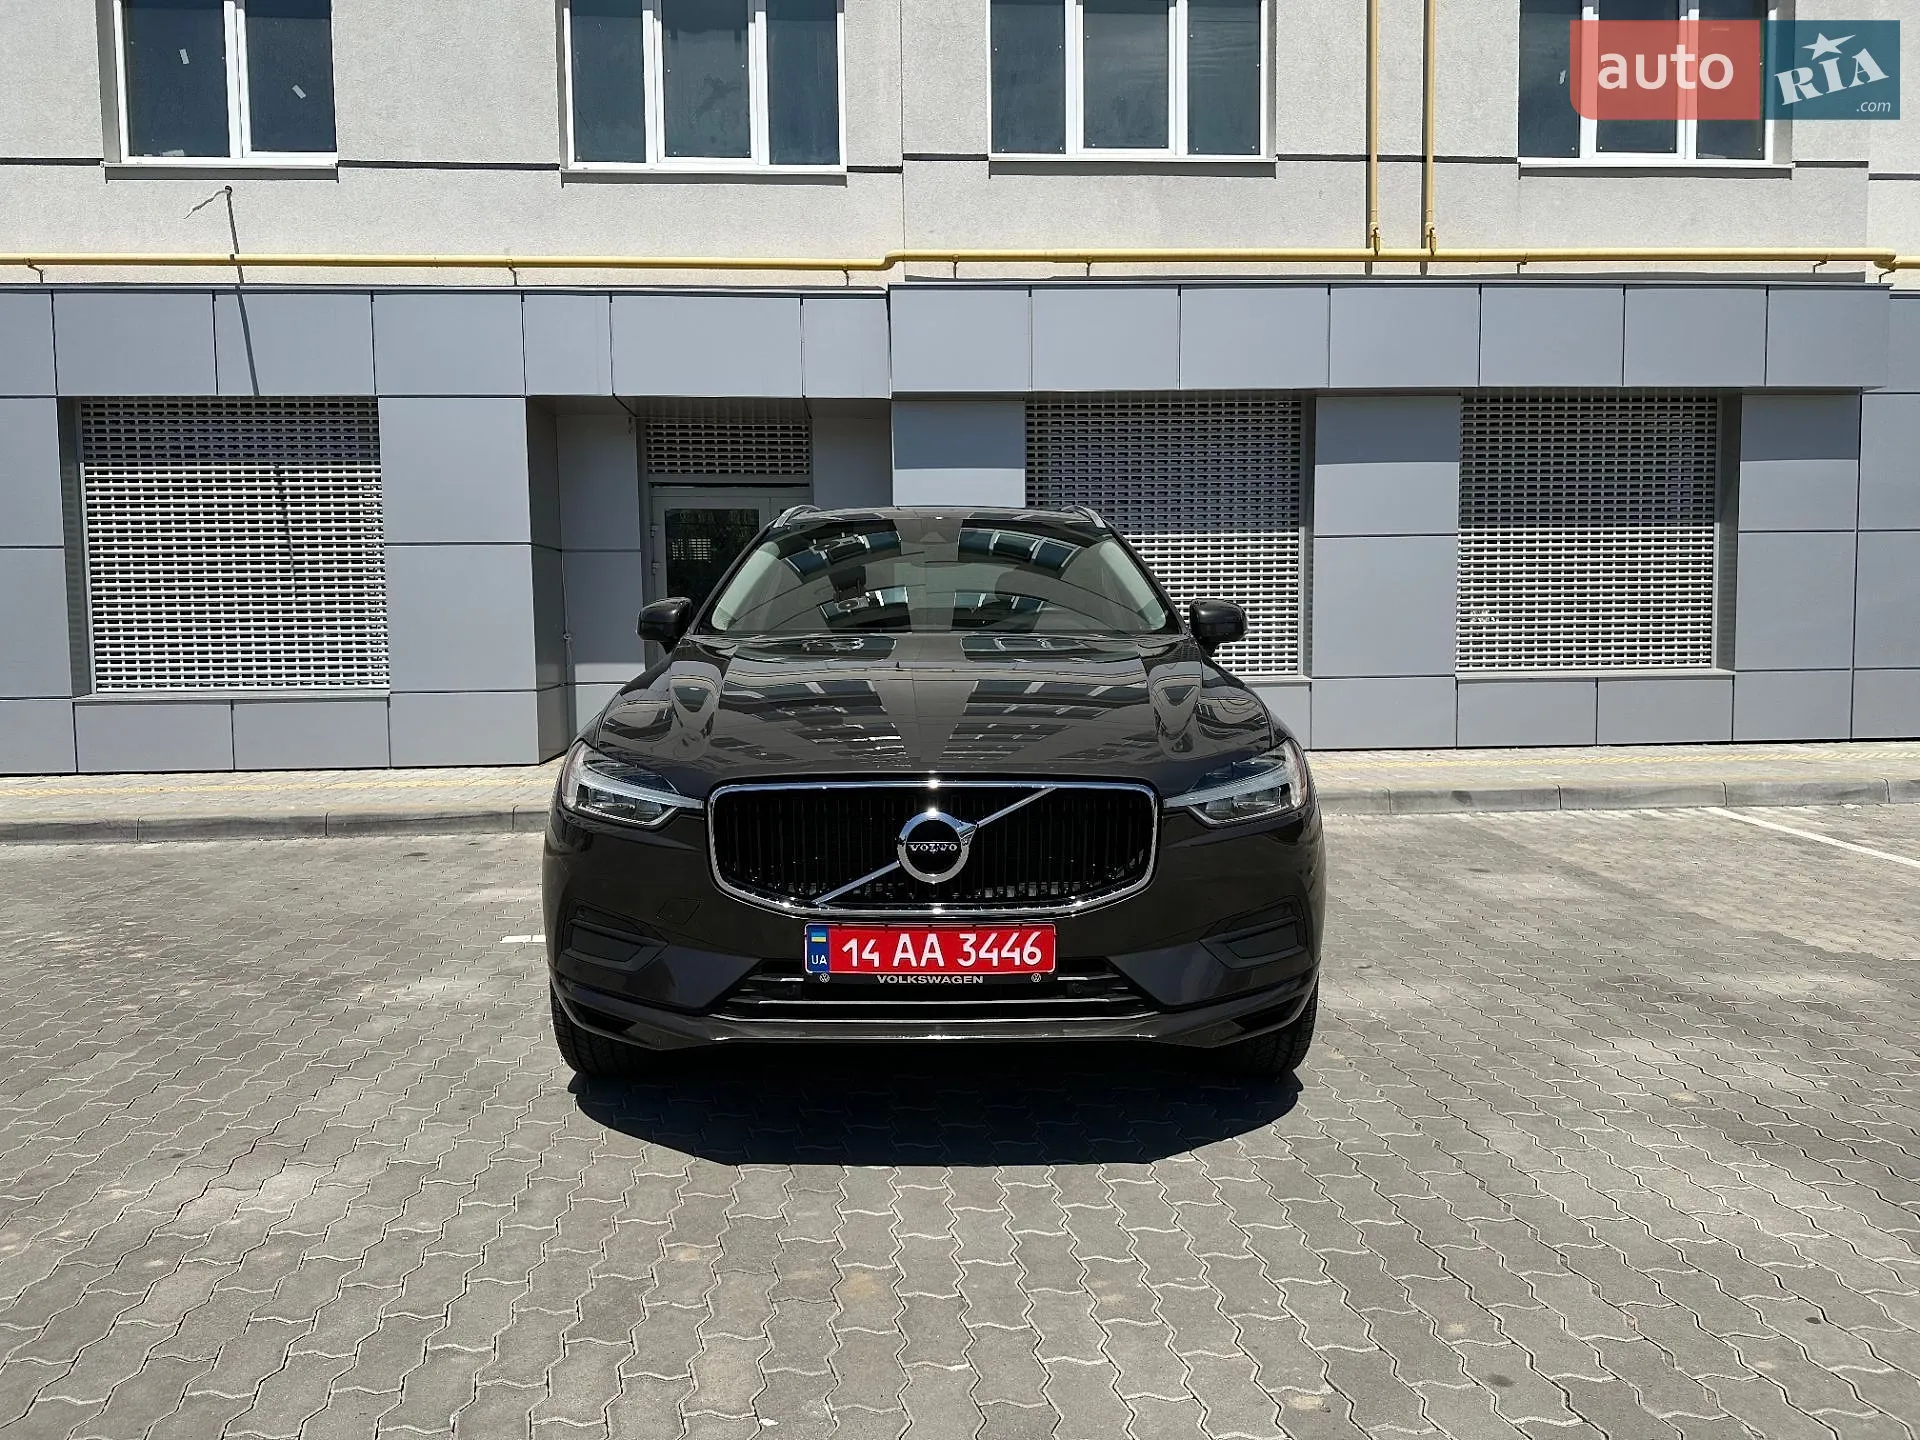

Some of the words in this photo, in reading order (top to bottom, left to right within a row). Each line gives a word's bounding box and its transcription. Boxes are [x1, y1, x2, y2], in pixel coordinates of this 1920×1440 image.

[908, 844, 958, 852] VOLVO
[842, 938, 880, 968] 14
[892, 933, 945, 968] AA
[957, 931, 1042, 967] 3446
[811, 955, 827, 965] UA
[877, 975, 983, 984] VOLKSWAGEN
